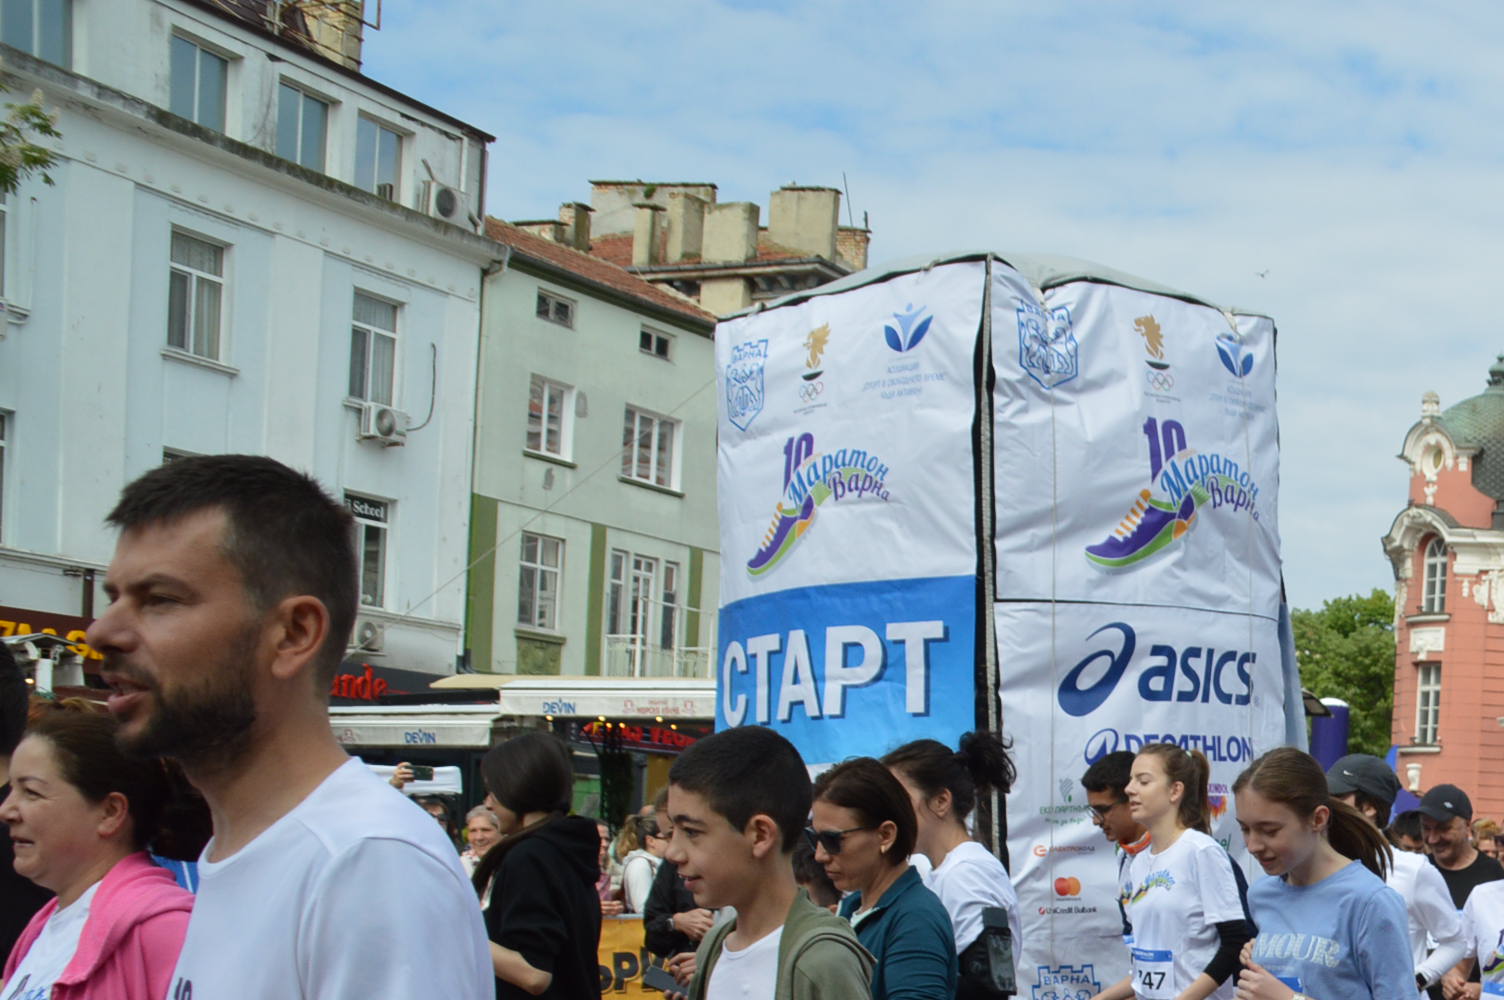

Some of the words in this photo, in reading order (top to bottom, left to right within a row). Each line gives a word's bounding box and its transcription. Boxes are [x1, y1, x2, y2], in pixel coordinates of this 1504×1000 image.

[783, 432, 814, 497] 10
[1143, 416, 1187, 485] 10
[788, 448, 889, 509] Маратон
[828, 471, 891, 502] Варна
[1160, 453, 1260, 508] Маратон
[353, 500, 385, 518] School
[1206, 475, 1260, 521] Варна
[722, 620, 946, 728] СТАРТ
[543, 700, 576, 714] DEVIN
[404, 731, 436, 744] DEVIN
[1043, 974, 1090, 986] ВАРНА
[1138, 969, 1167, 991] 47
